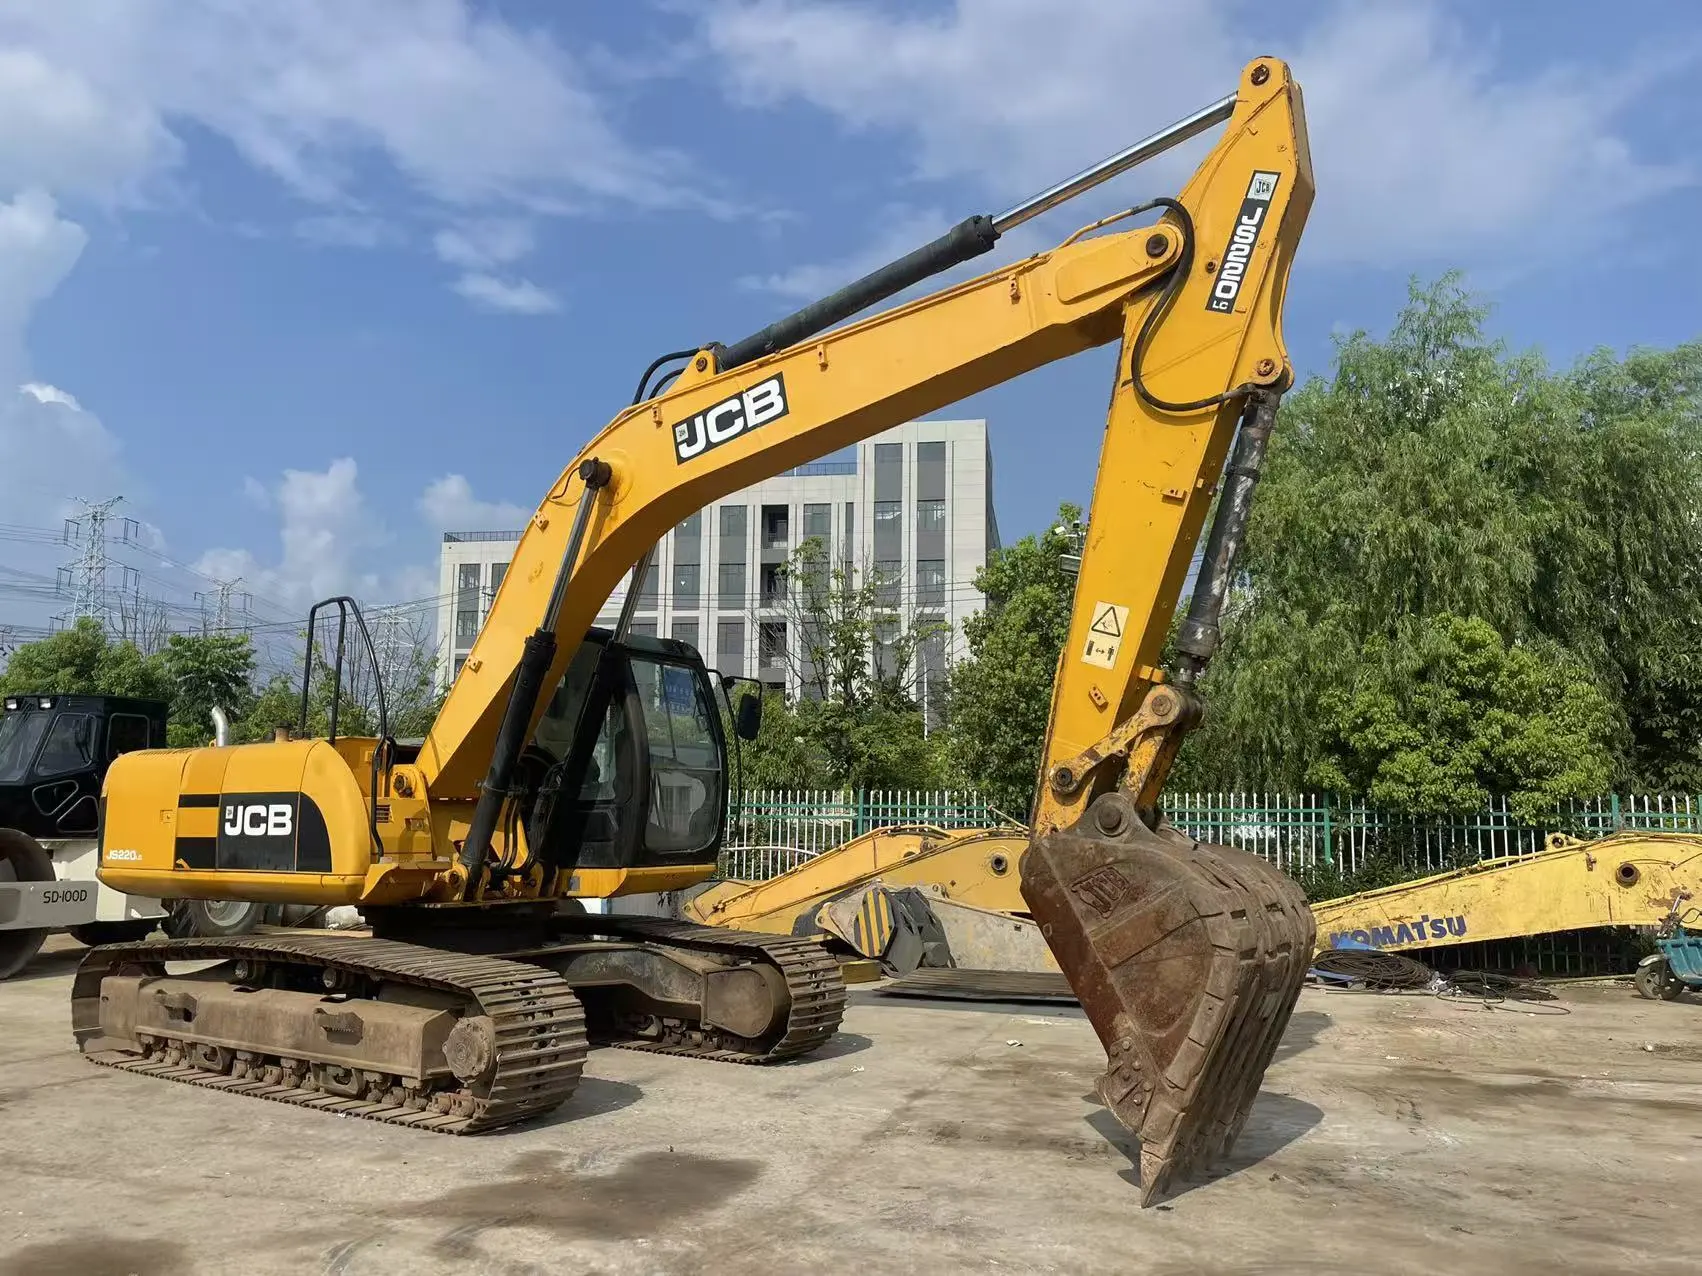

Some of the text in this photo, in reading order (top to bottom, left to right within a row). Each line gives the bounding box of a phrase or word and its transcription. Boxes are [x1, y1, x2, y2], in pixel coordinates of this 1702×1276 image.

[1256, 181, 1270, 193] JCB
[1212, 207, 1263, 310] JS220 LC
[677, 379, 784, 458] JCB
[224, 804, 293, 836] JCB
[106, 849, 137, 861] JS220
